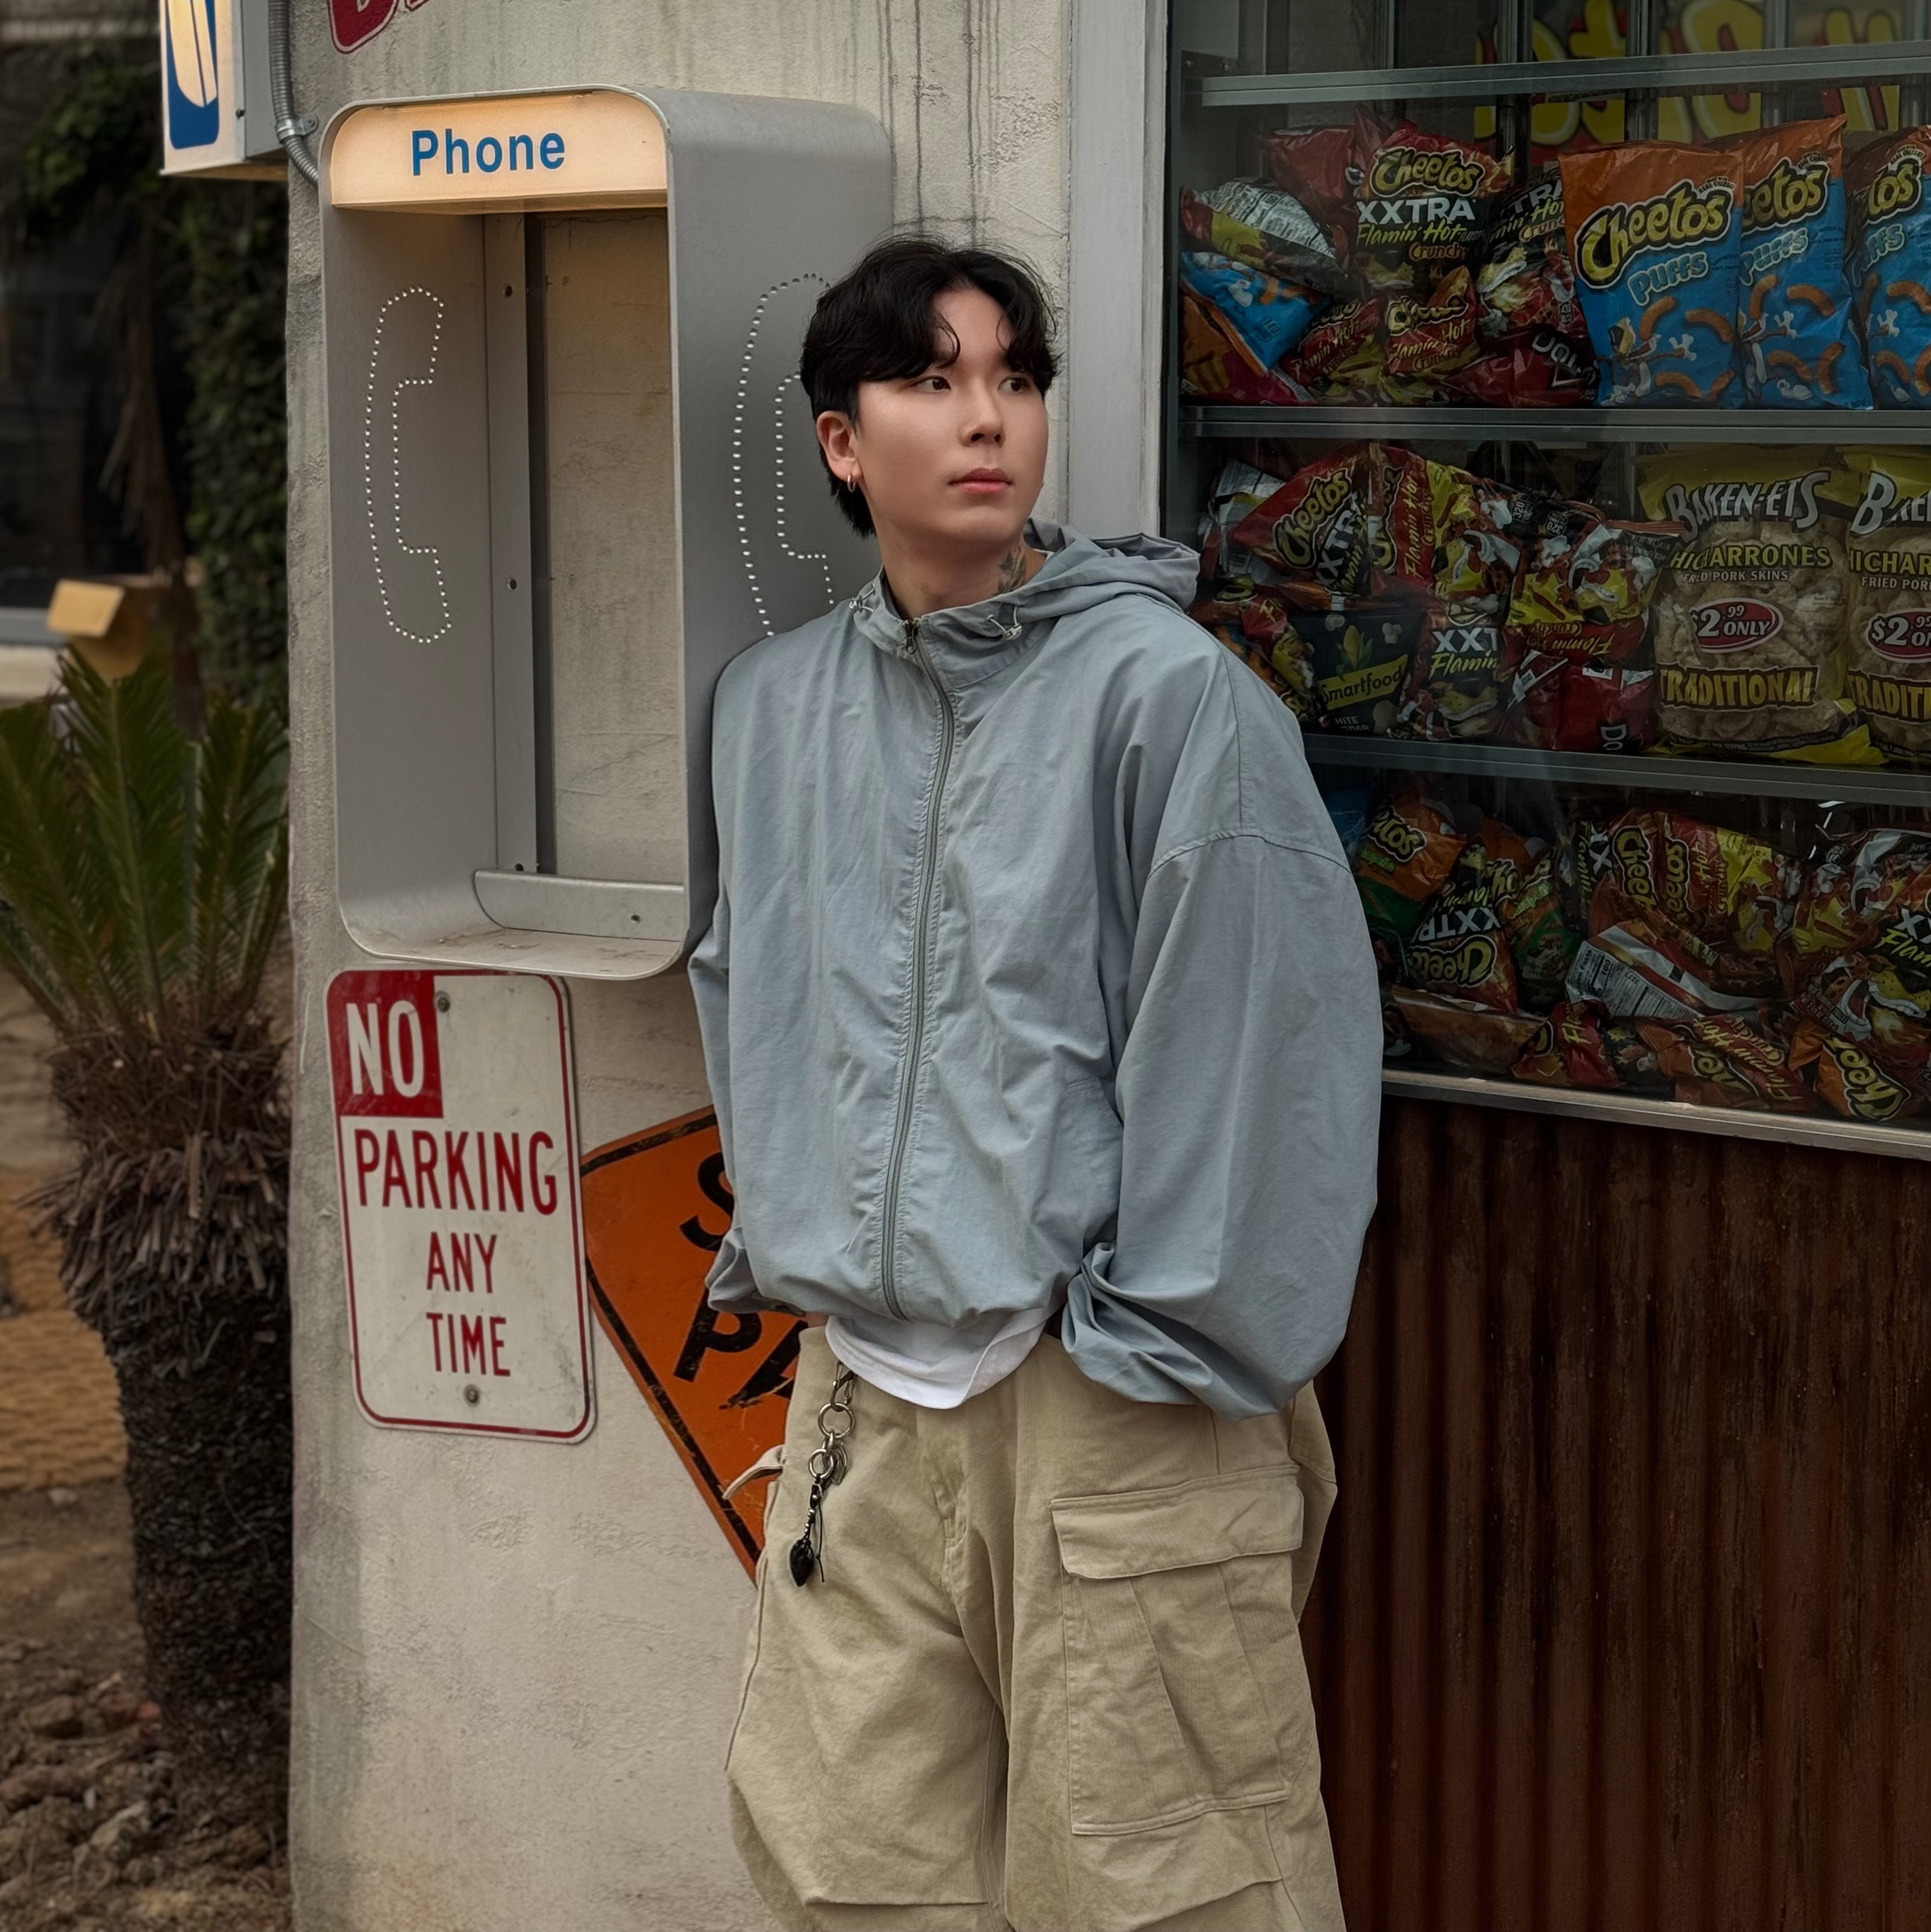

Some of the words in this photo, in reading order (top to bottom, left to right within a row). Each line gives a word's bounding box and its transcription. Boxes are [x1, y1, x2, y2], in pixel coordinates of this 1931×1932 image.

[411, 128, 565, 176] Phone
[1372, 147, 1483, 194] Cheetos
[1355, 197, 1476, 225] XXTRA
[1356, 221, 1423, 246] Flamin'
[1423, 216, 1468, 244] Hot
[1577, 183, 1729, 285] Cheetos
[1401, 470, 1419, 509] Hot
[1512, 500, 1526, 519] 320
[1275, 470, 1350, 566] Cheetos
[1713, 571, 1747, 582] PORK
[1750, 570, 1789, 582] SKINS
[1862, 576, 1897, 588] FRIED
[1722, 620, 1771, 636] ONLY
[1321, 664, 1403, 704] Smartfood
[345, 999, 425, 1098] NO
[354, 1129, 558, 1216] PARKING
[426, 1232, 498, 1294] ANY
[425, 1312, 511, 1377] TIME
